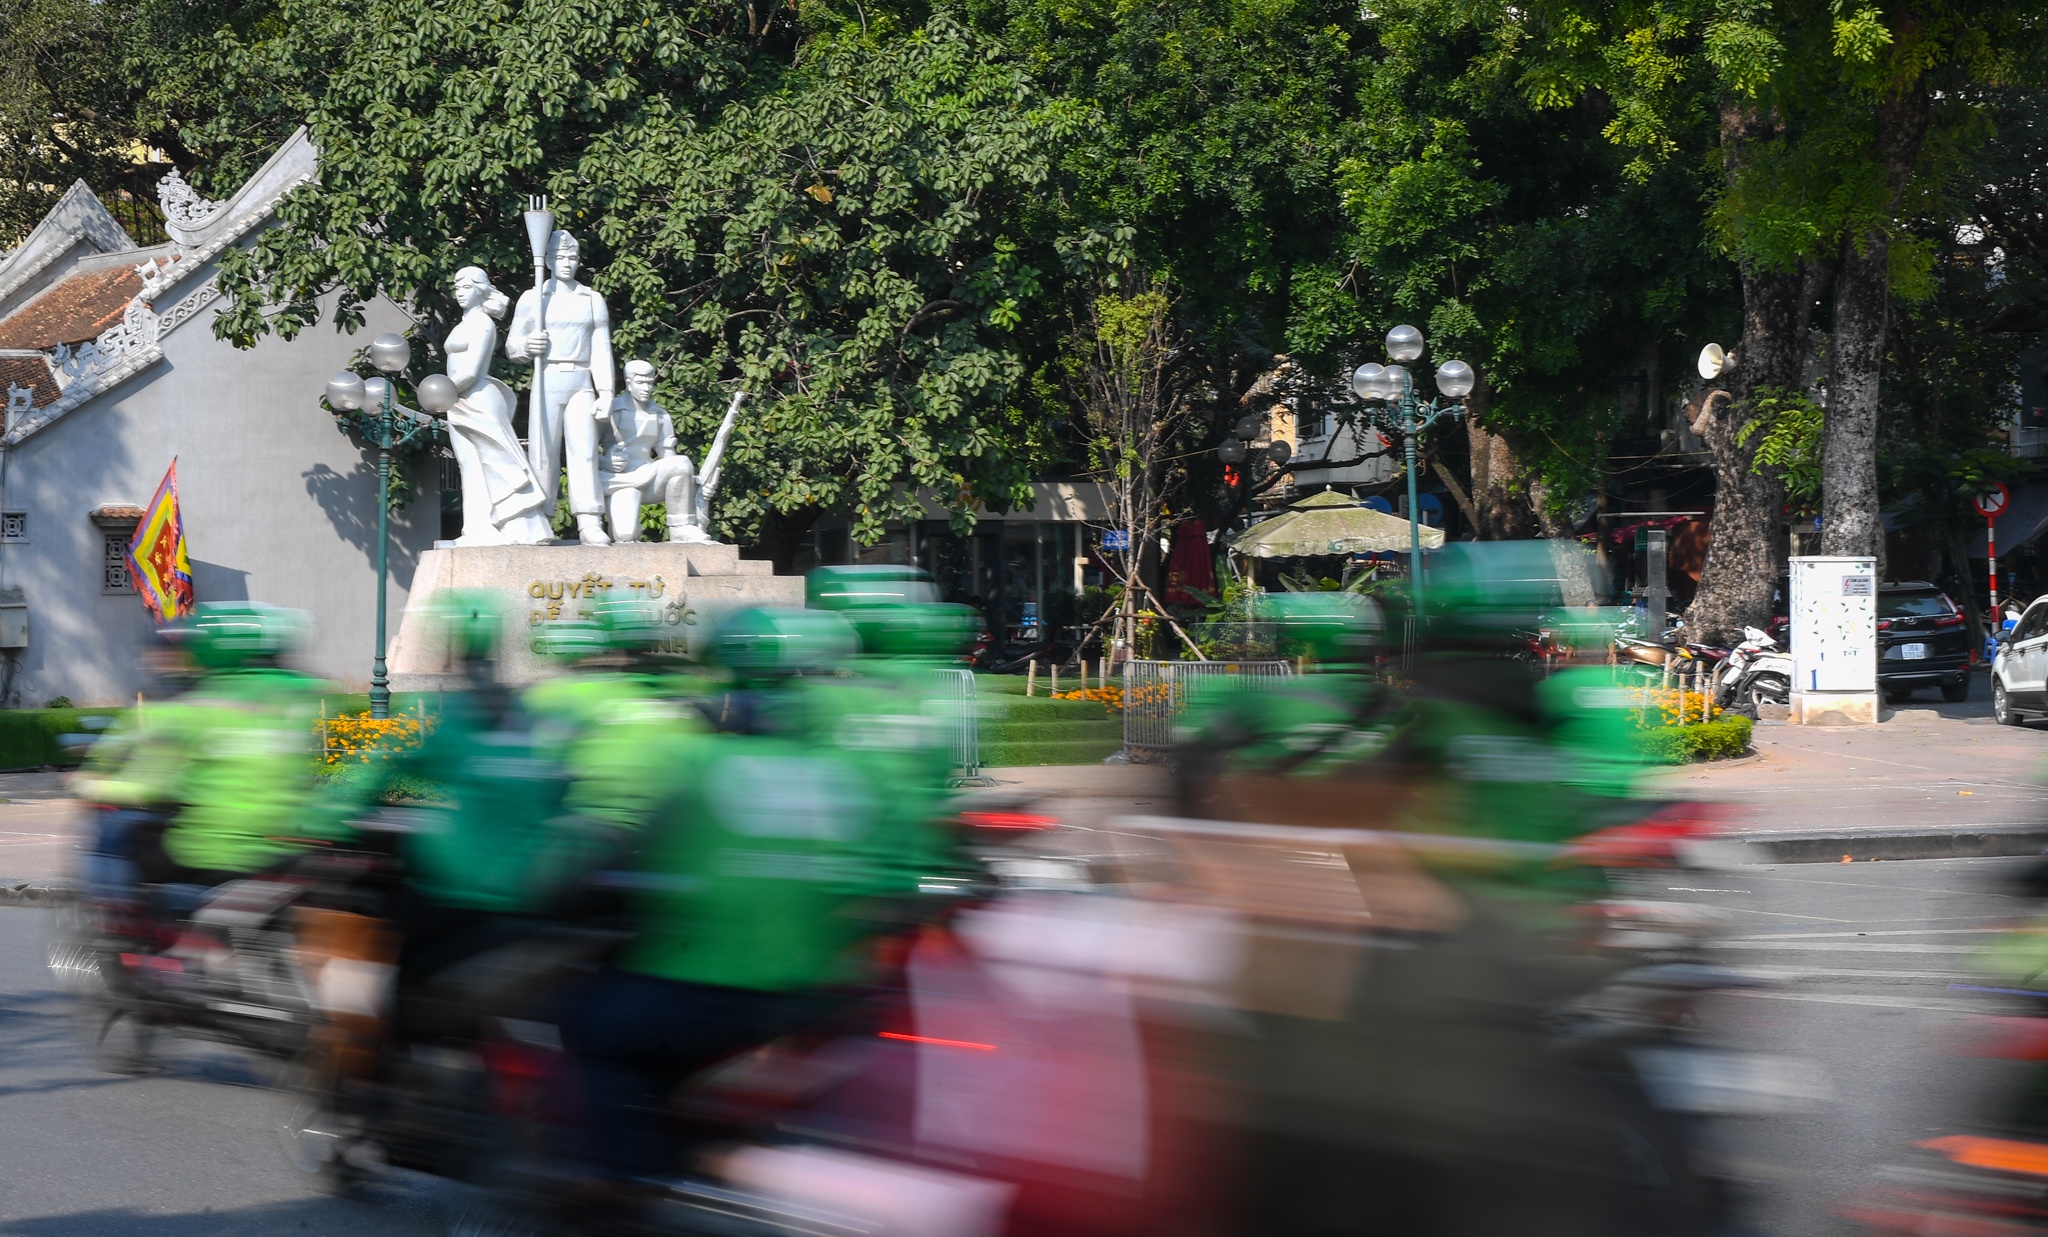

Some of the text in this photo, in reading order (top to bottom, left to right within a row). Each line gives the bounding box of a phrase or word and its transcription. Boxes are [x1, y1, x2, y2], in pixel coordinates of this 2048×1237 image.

[528, 574, 665, 599] QUYẾT TỬ
[641, 592, 697, 626] UỐC
